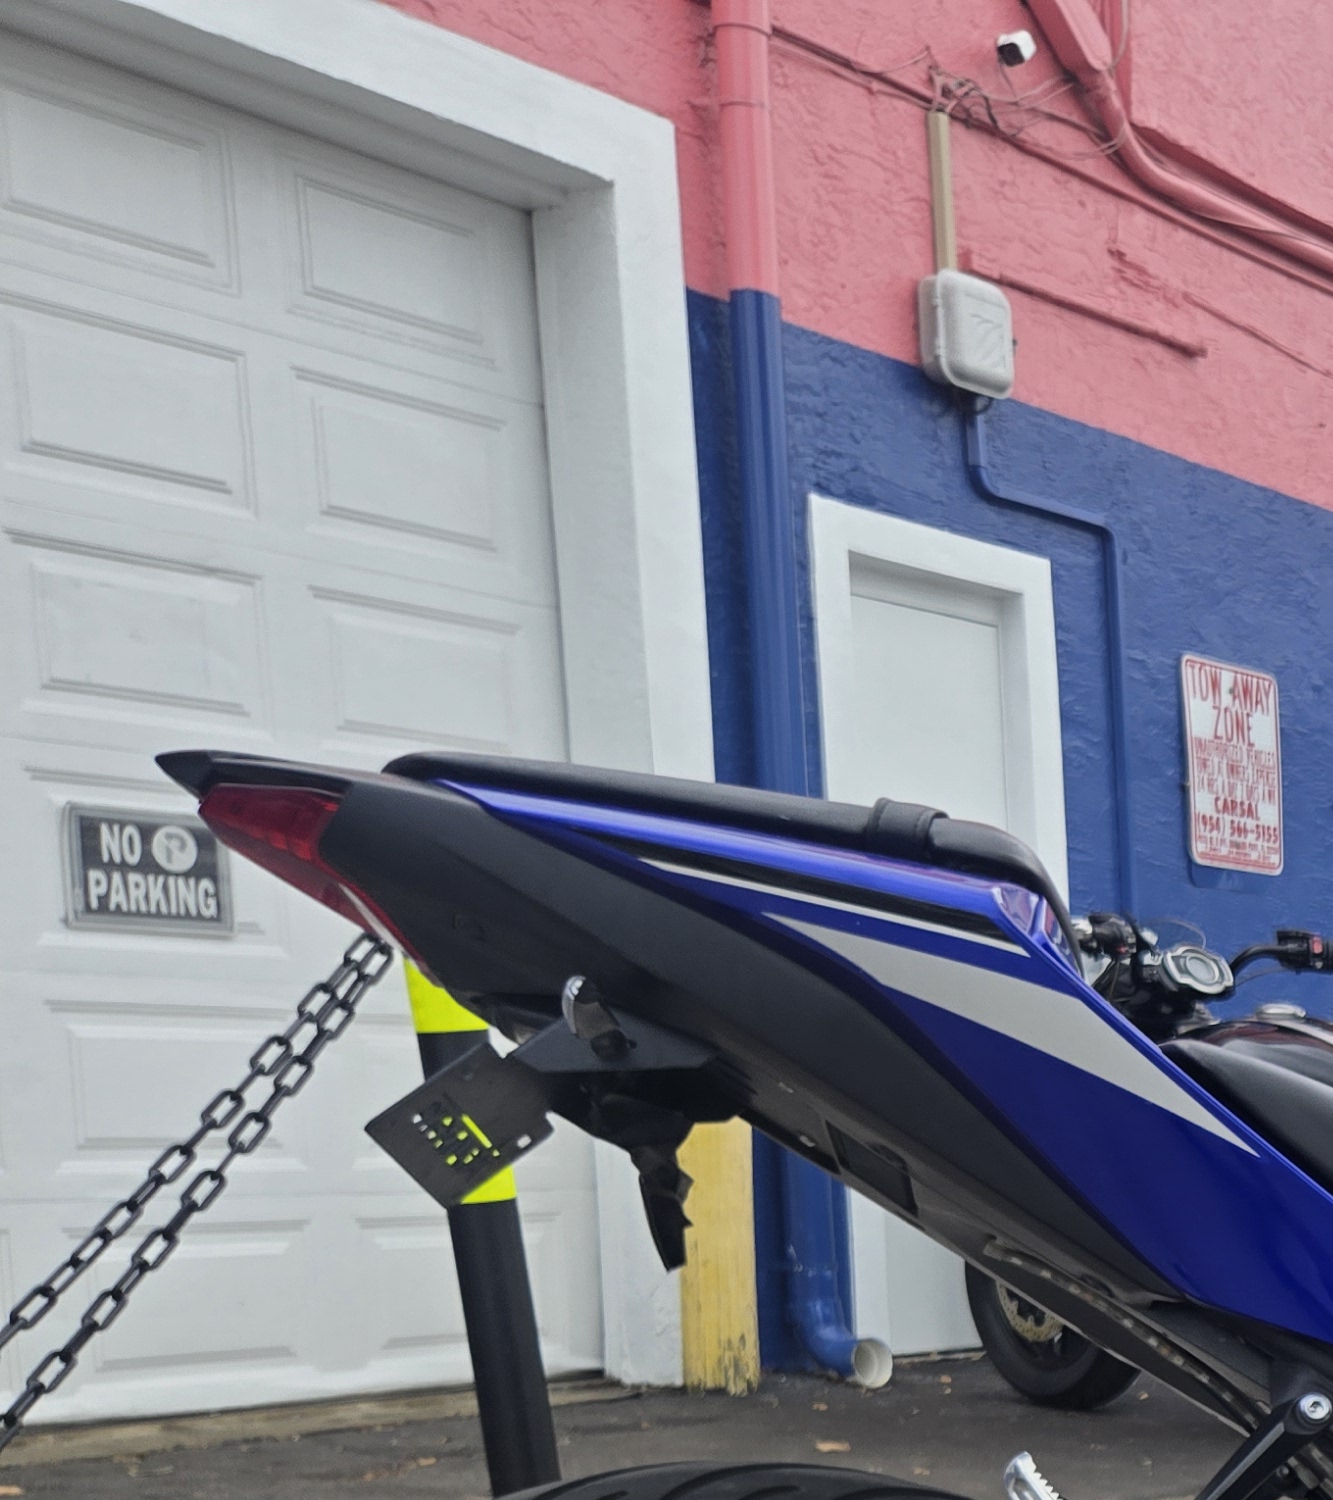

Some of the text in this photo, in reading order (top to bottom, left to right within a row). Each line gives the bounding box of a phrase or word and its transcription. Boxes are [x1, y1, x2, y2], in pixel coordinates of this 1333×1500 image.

[1189, 664, 1273, 716] TOW AWAY
[1212, 706, 1255, 747] ZONE
[101, 822, 142, 866] NO
[87, 868, 218, 918] PARKING
